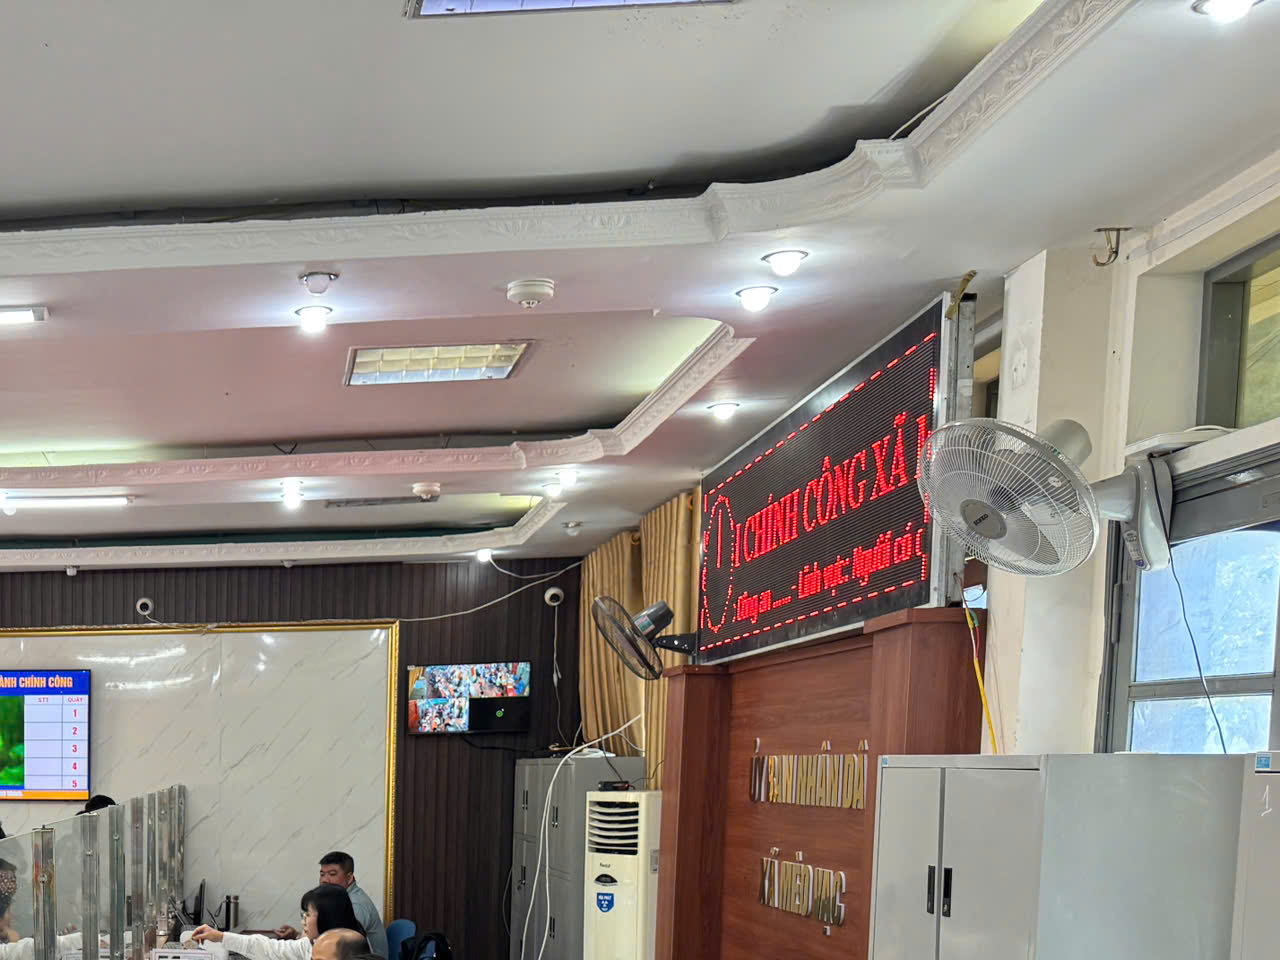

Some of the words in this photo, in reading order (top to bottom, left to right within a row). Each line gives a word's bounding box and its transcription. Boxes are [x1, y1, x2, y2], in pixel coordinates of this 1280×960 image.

[744, 489, 800, 562] CHÍNH
[803, 456, 867, 532] CÔNG
[870, 411, 909, 500] XÃ
[19, 674, 46, 688] CHÍNH
[48, 674, 73, 688] CÔNG
[73, 709, 78, 717] 1
[72, 727, 78, 735] 2
[72, 744, 78, 753] 3
[72, 762, 78, 770] 4
[797, 740, 843, 808] NHÂN
[72, 780, 78, 788] 5
[760, 846, 779, 908] XÃ
[814, 867, 846, 936] VẠC
